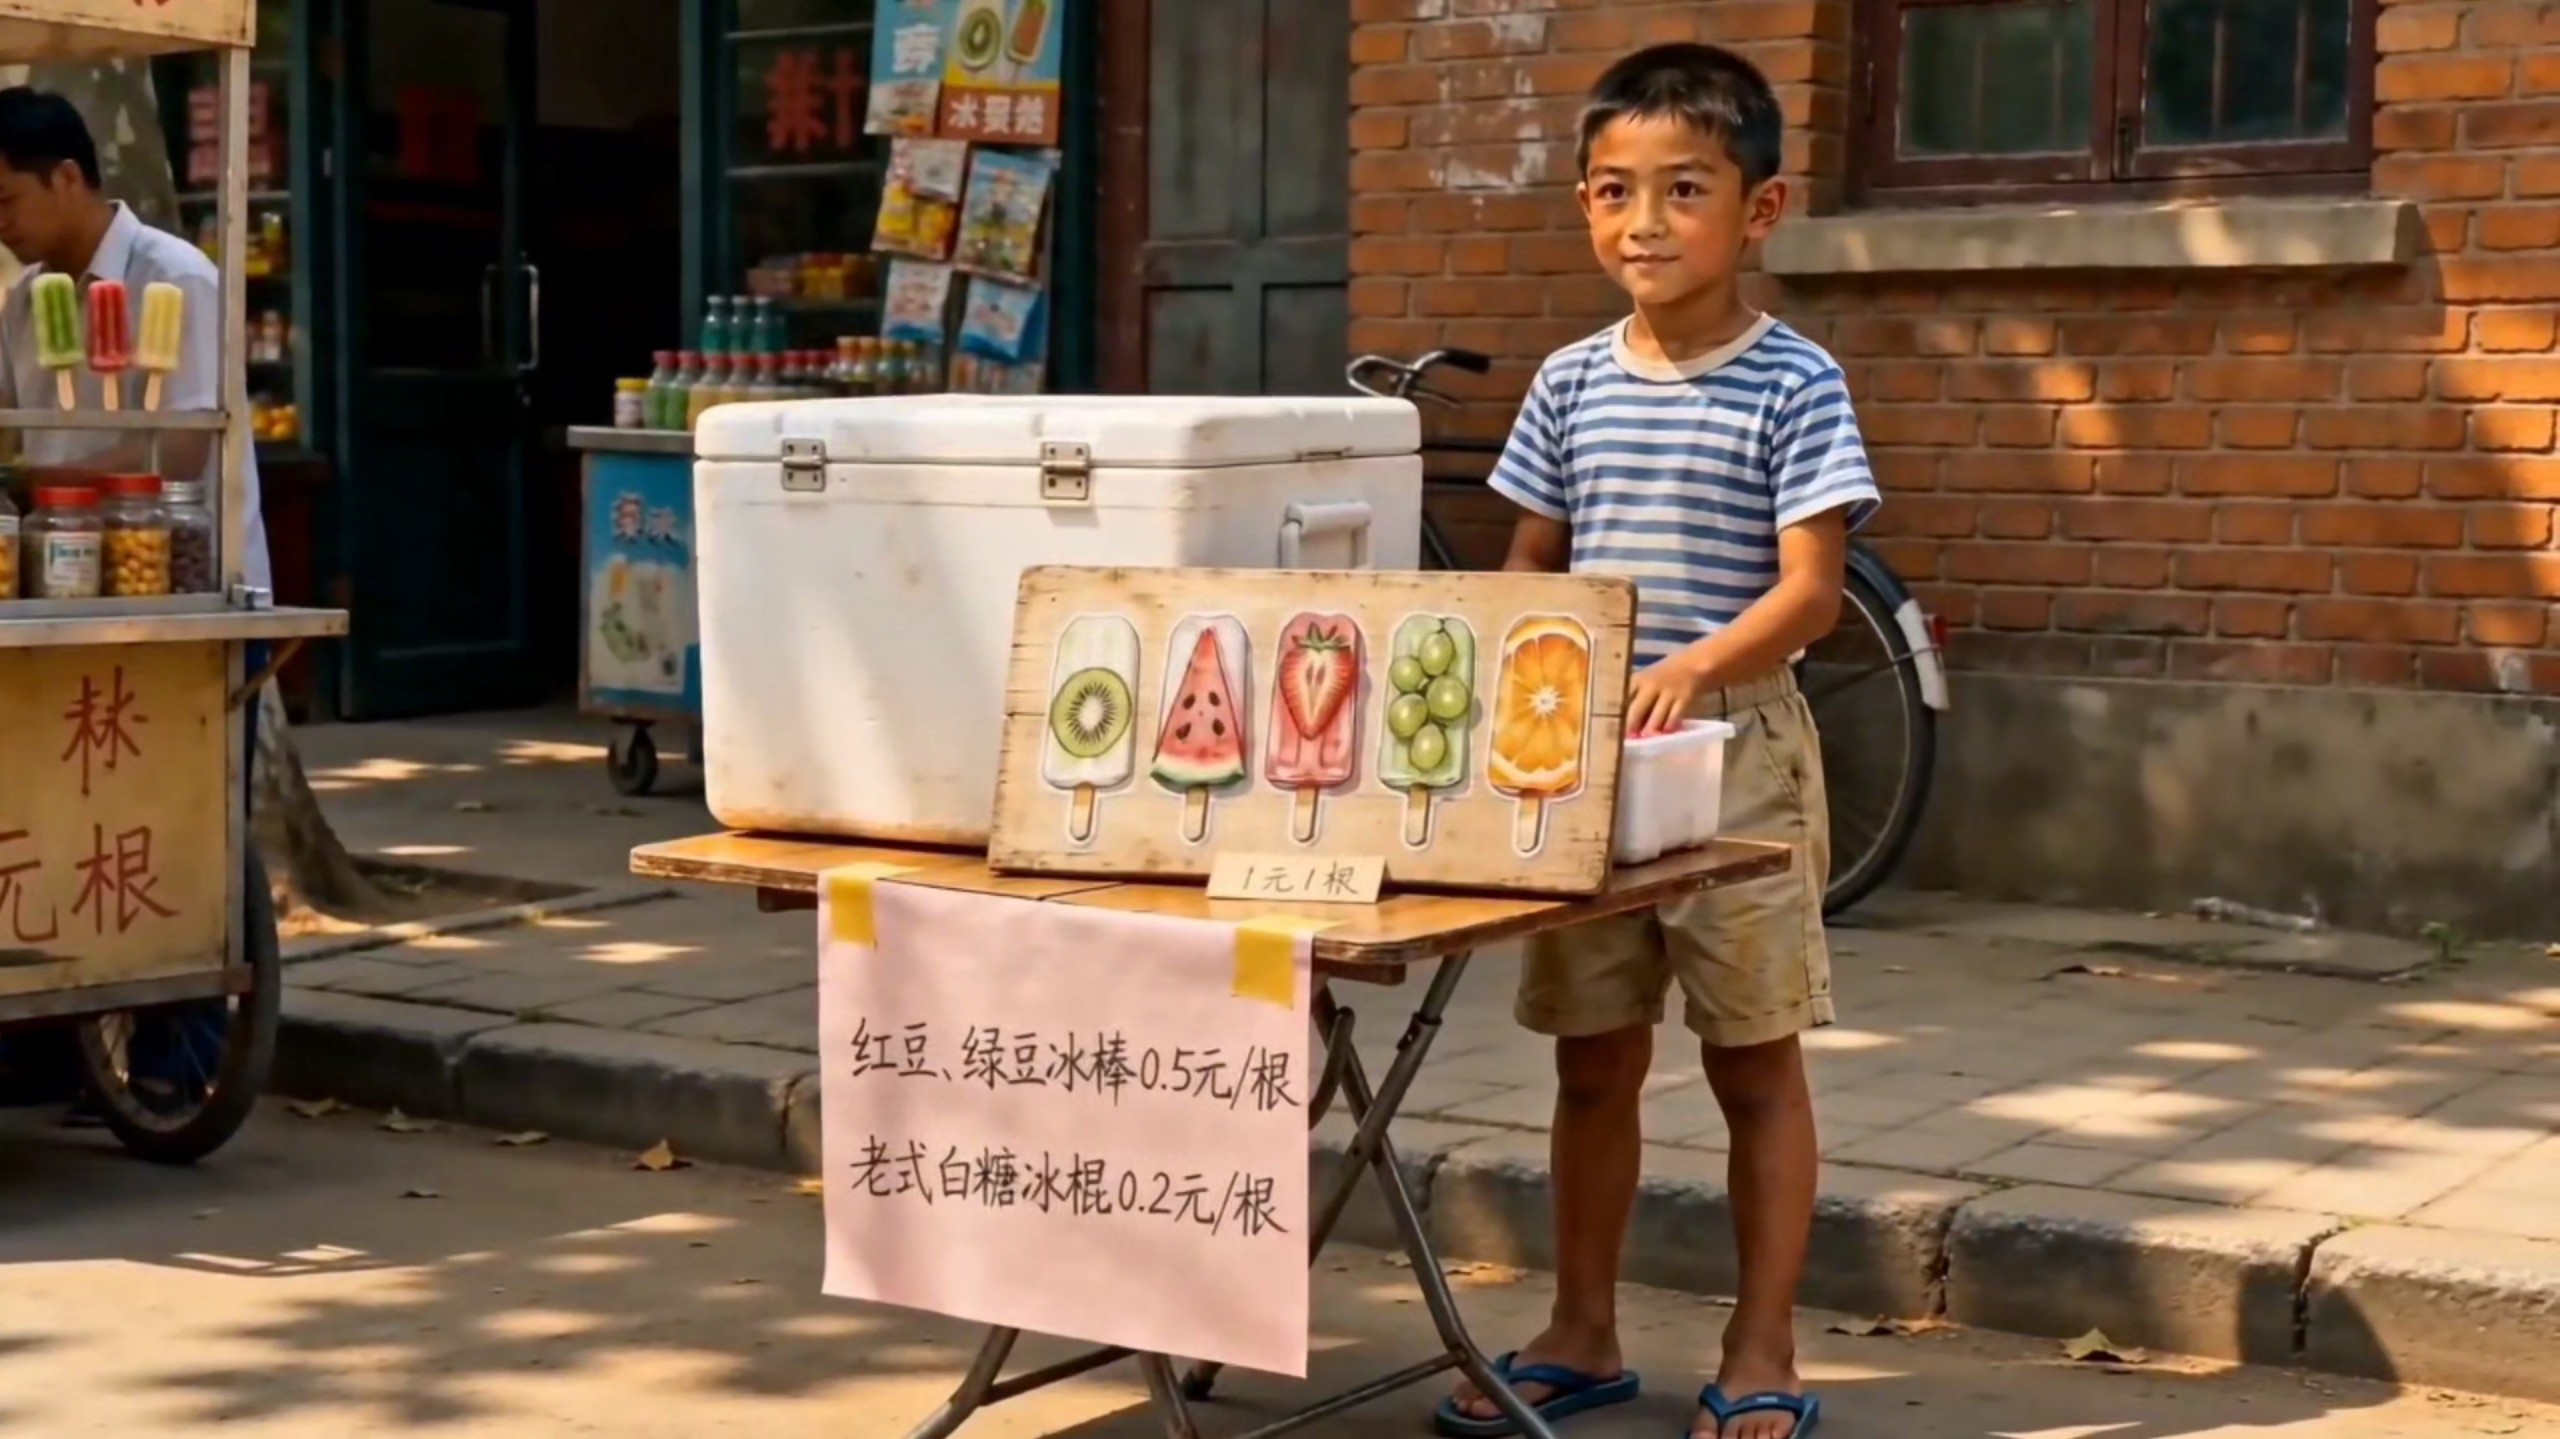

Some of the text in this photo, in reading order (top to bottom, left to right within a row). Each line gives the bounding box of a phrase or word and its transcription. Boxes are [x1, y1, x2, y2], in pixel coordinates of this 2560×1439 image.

[851, 1017, 1300, 1111] 红豆、绿豆冰棒0.5元/根
[850, 1134, 1289, 1237] 老式白糖冰棍0.2元/根
